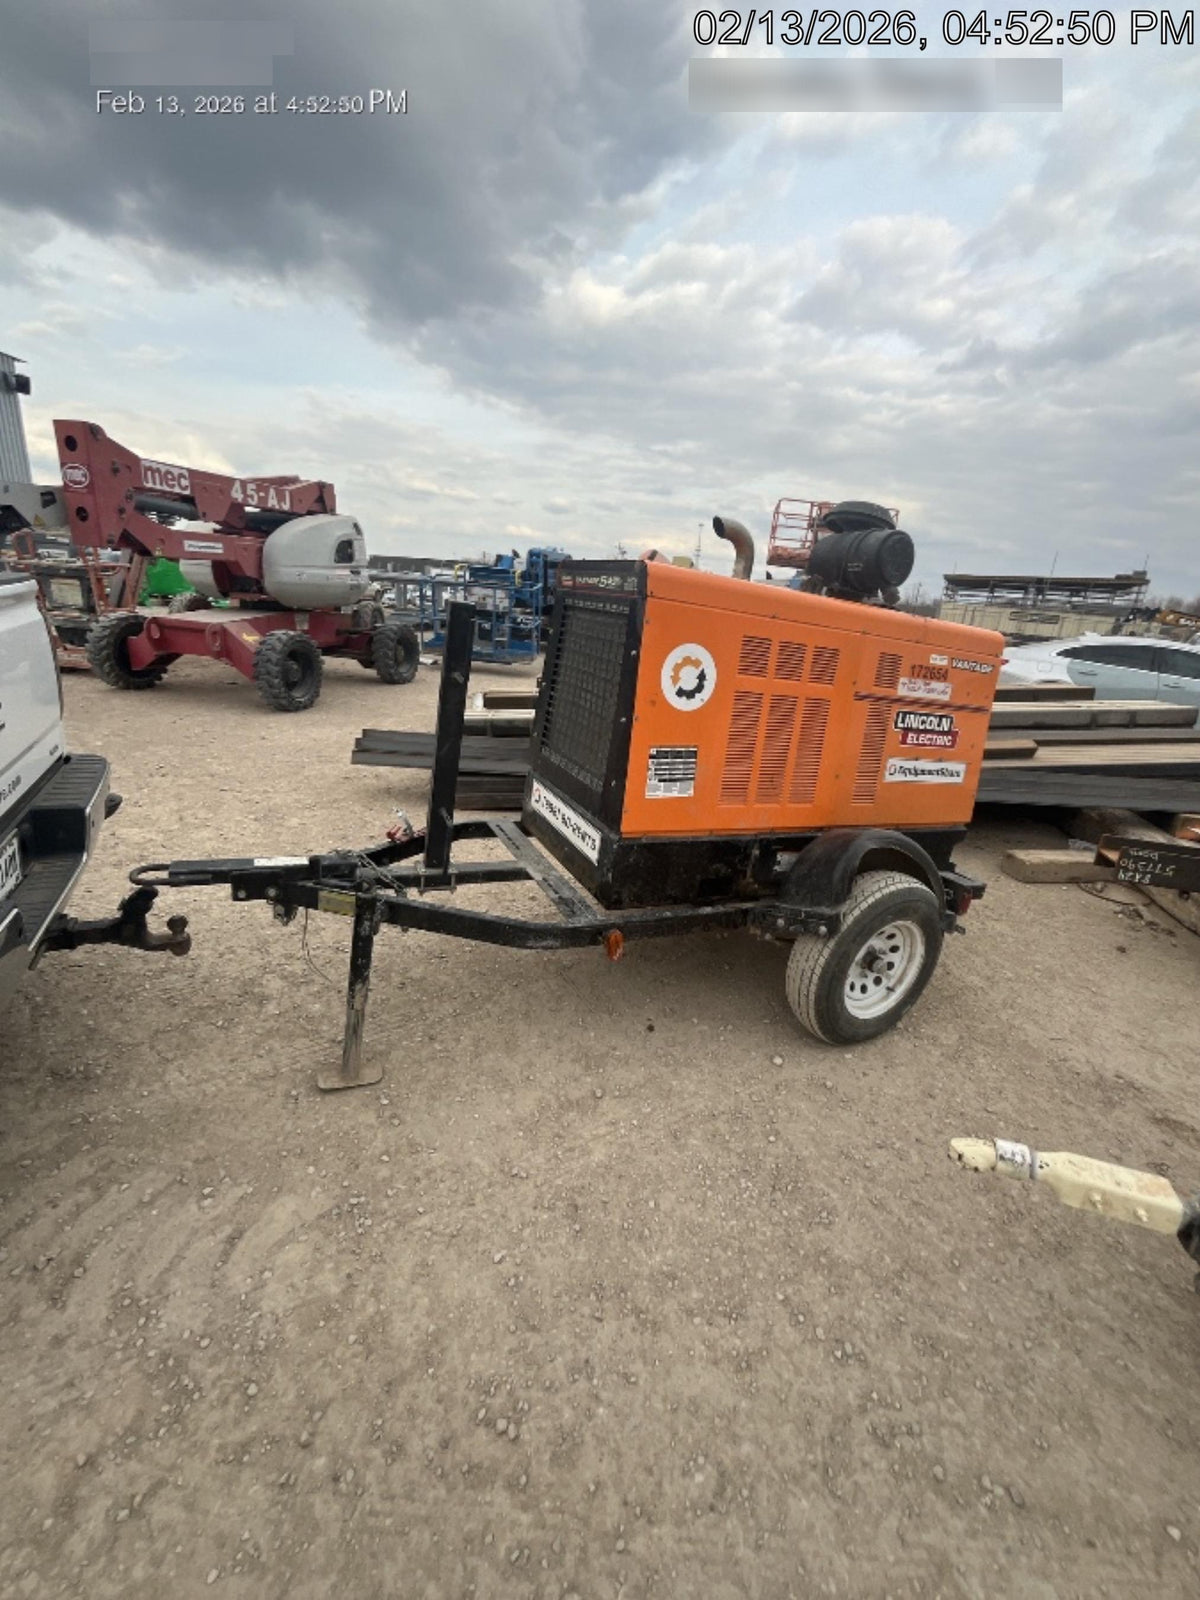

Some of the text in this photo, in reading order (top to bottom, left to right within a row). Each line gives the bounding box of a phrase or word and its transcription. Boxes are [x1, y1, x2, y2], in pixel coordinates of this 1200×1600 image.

[142, 463, 190, 491] mec
[896, 712, 954, 732] LINCOLN
[906, 733, 953, 746] ELECTRIC
